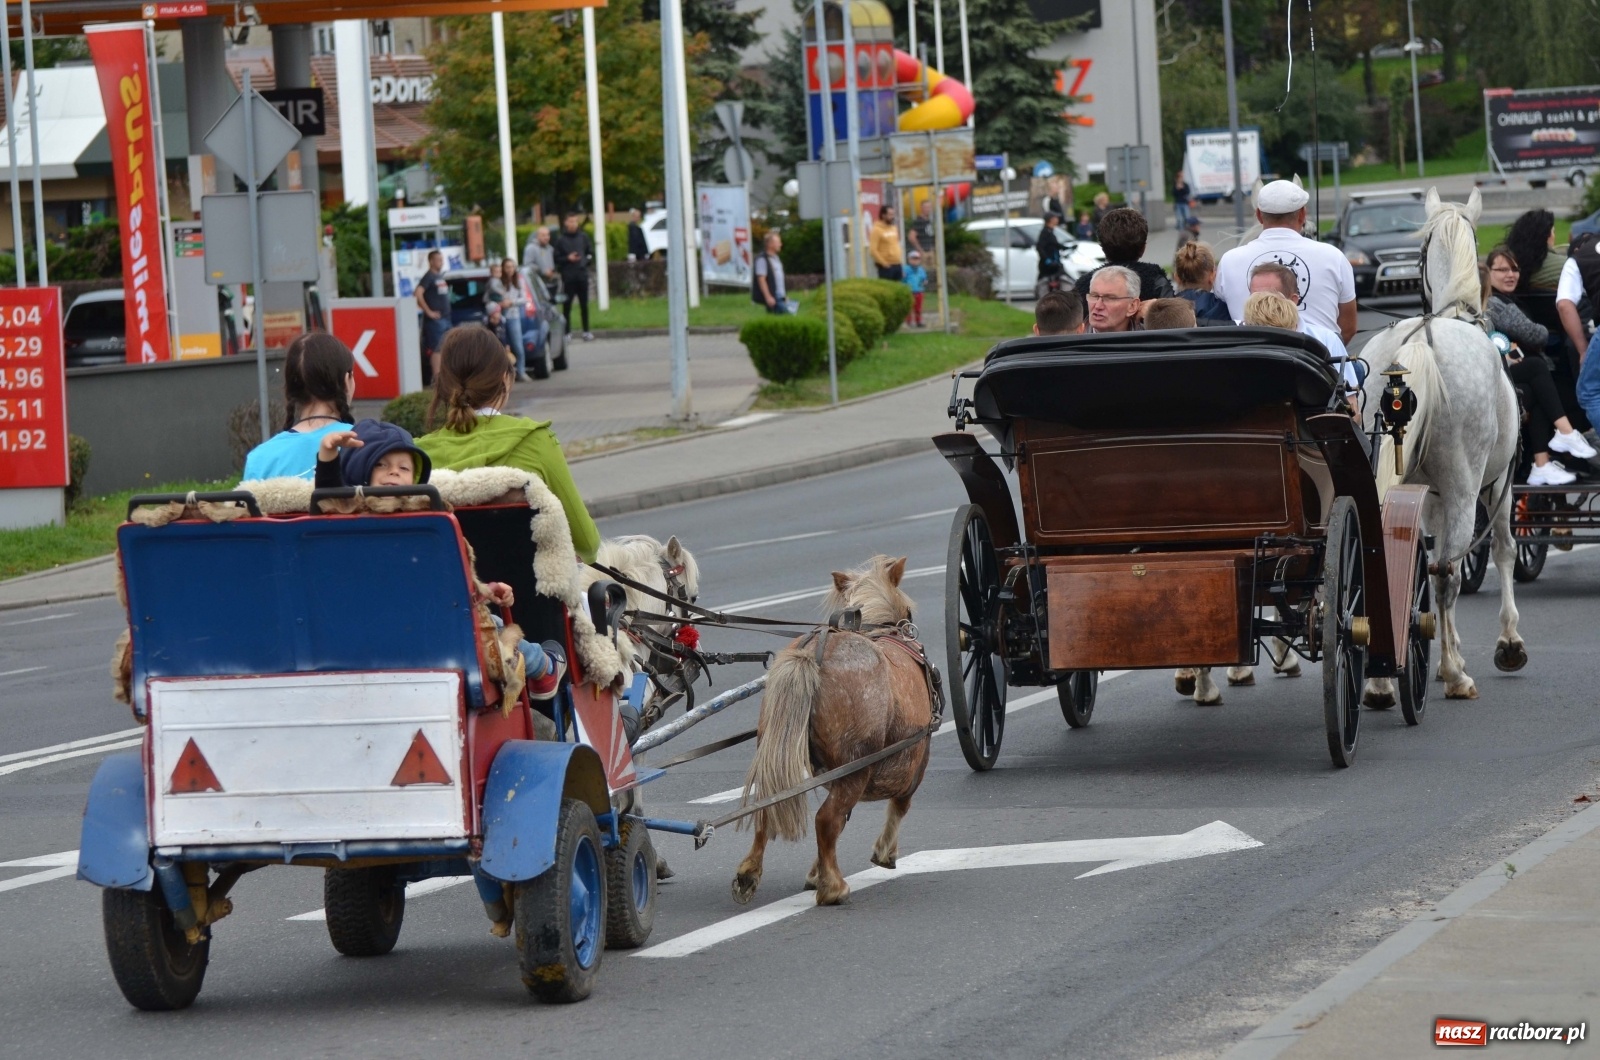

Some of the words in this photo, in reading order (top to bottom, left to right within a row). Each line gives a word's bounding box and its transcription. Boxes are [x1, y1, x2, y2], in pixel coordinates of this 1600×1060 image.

[160, 6, 180, 15] max.
[1546, 109, 1575, 123] sushi
[0, 305, 42, 329] ,04
